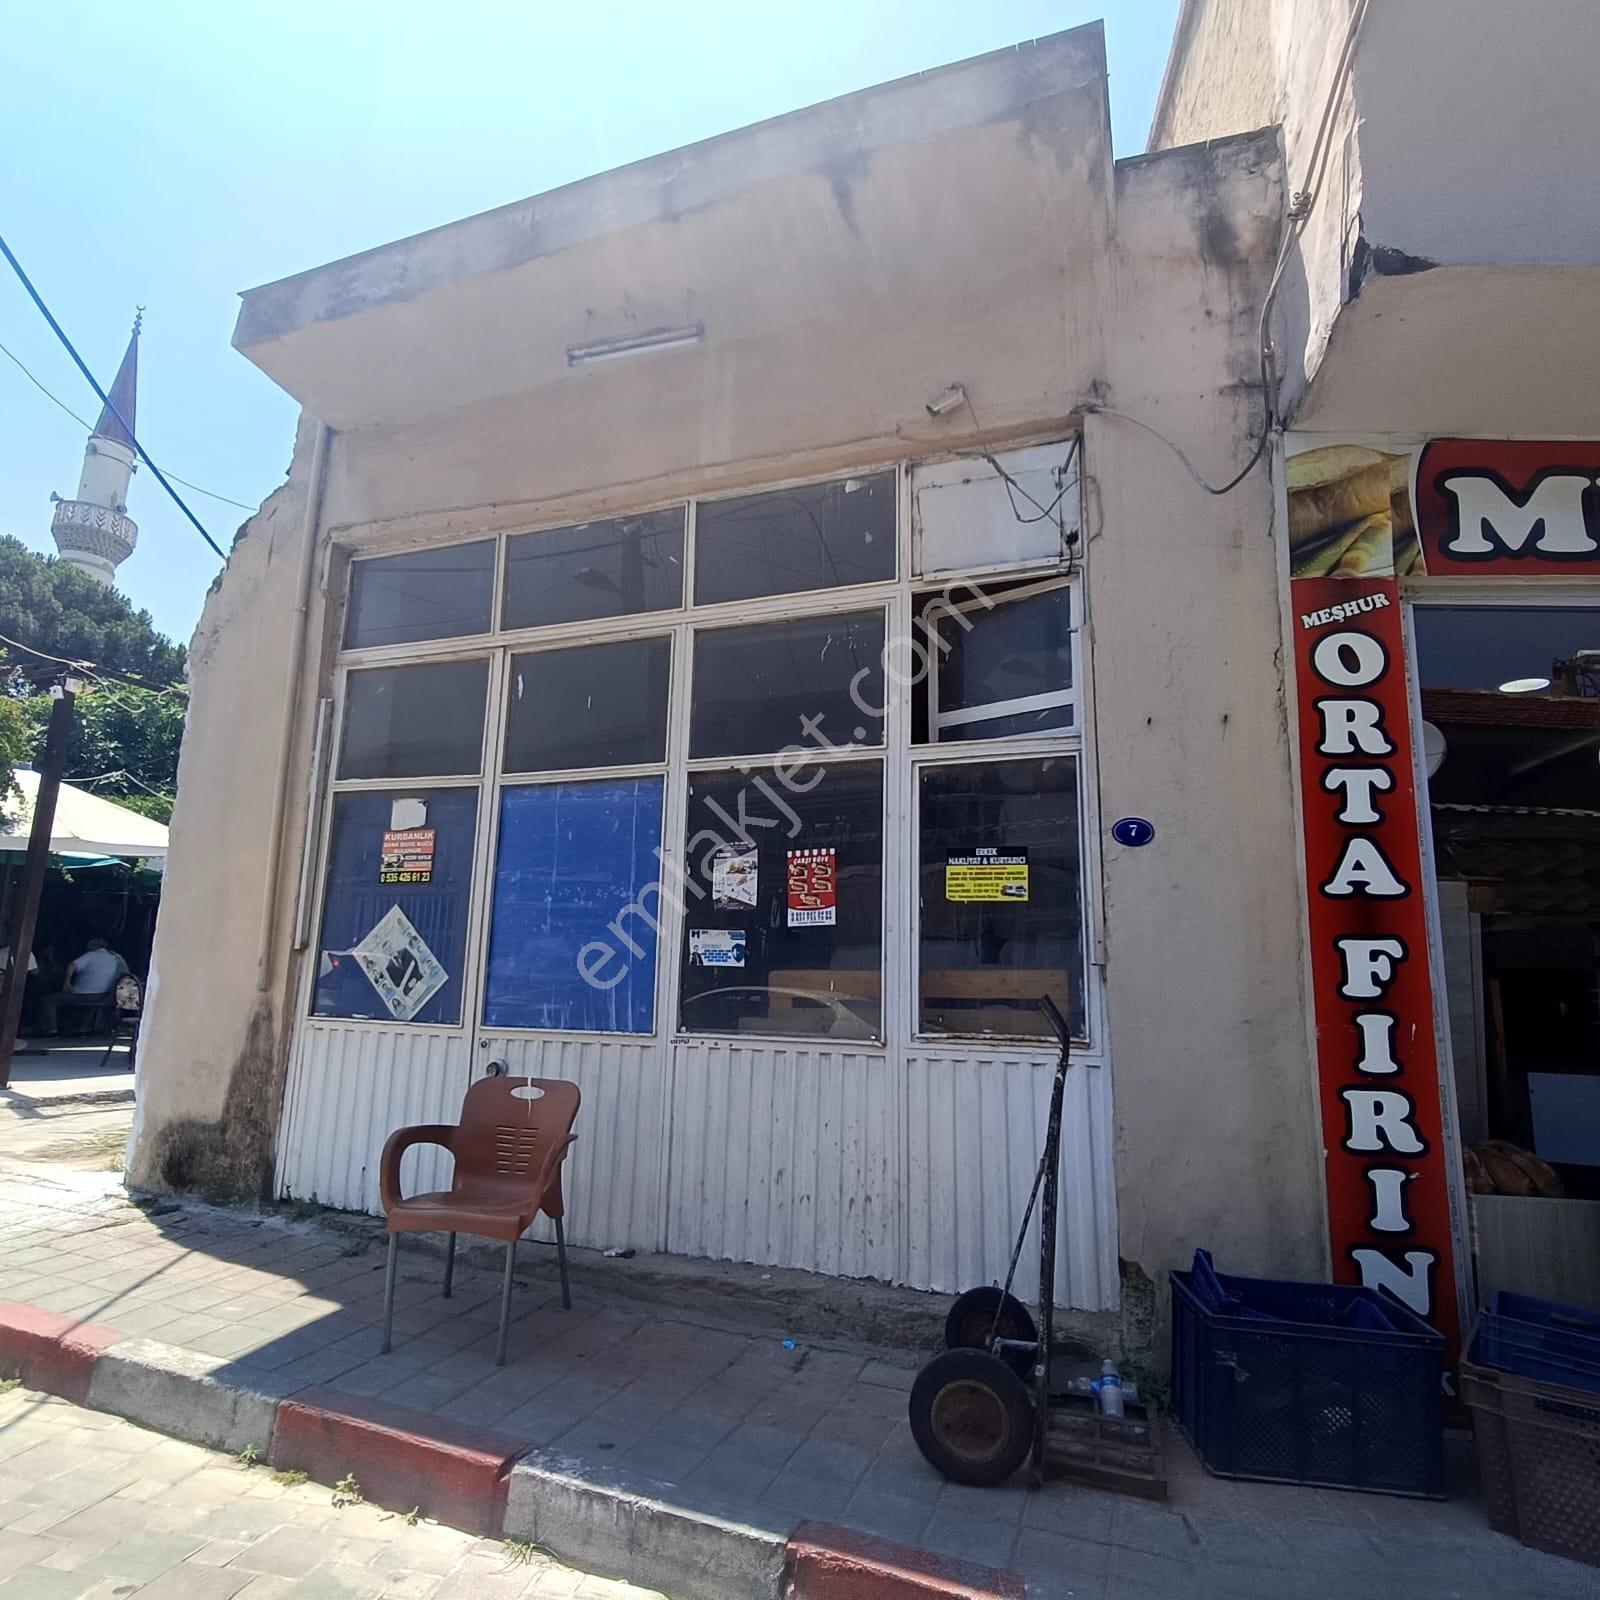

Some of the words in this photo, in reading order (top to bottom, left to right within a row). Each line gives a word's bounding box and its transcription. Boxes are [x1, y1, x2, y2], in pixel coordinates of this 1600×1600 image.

[1445, 475, 1600, 552] M
[1301, 593, 1390, 629] MEŞHUR
[1314, 632, 1406, 895] ORTA
[385, 832, 434, 841] KURBANLIK
[1129, 824, 1138, 837] 7
[948, 855, 982, 865] NAKLİYAT
[982, 856, 989, 865] &
[989, 856, 1026, 865] KURTARICI
[1338, 939, 1435, 1316] FIRIN
